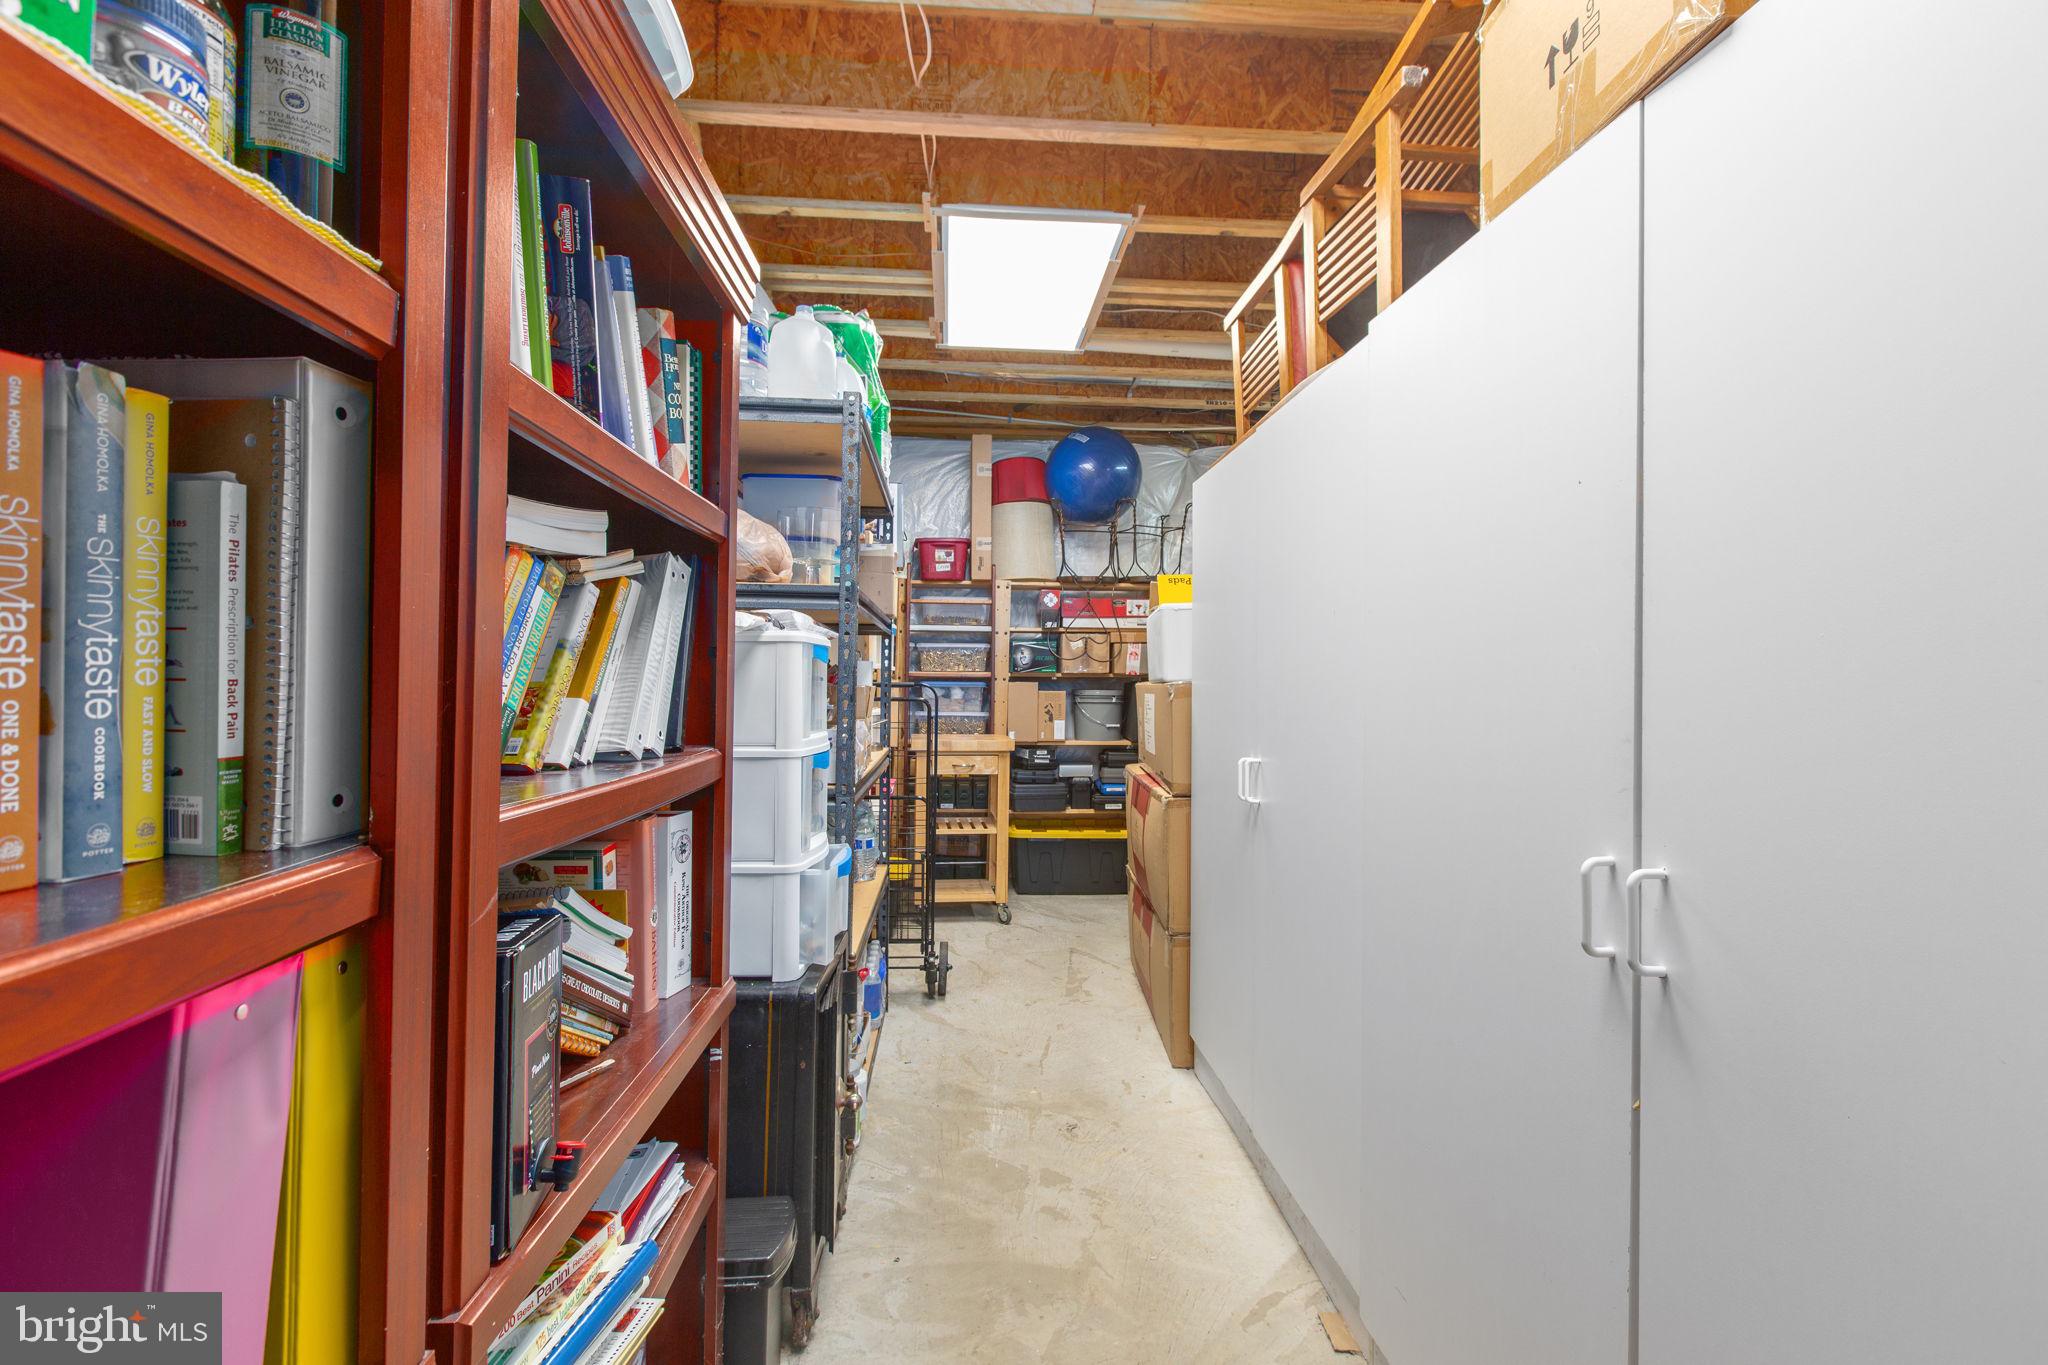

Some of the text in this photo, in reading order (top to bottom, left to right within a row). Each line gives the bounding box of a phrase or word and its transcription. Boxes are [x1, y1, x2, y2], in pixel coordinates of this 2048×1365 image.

[269, 27, 325, 51] CLASSICS
[270, 18, 324, 42] ITALIAN
[263, 56, 328, 82] BALSAMIC
[265, 65, 327, 91] VINEGAR
[561, 206, 572, 252] Johnsonville
[96, 393, 110, 492] GINA HOMOLKA
[0, 375, 41, 813] GINA HOMOLKA skinnytaste ONE & DONE
[127, 412, 166, 793] GINA HOMOLKA skinnytaste FAST AND SLOW
[517, 566, 541, 624] BAREFOOT
[1167, 576, 1191, 585] Pads
[225, 513, 240, 740] The Pilates Prescription for Back Pain
[504, 605, 534, 679] COMFORT FOOD
[516, 590, 553, 684] MEDITERRANEAN
[78, 514, 120, 800] THE skinnytaste COOKBOOK
[543, 665, 571, 733] COOKBOOK
[82, 846, 114, 858] POTTER
[522, 956, 547, 1004] BLACK
[547, 945, 560, 982] BOX
[566, 974, 581, 990] GREAT
[581, 982, 602, 1001] CHOCOLATE
[516, 1300, 535, 1321] Best
[536, 1262, 570, 1304] Panini
[572, 1243, 598, 1269] Recipes
[536, 1331, 546, 1349] 125
[546, 1319, 559, 1335] best
